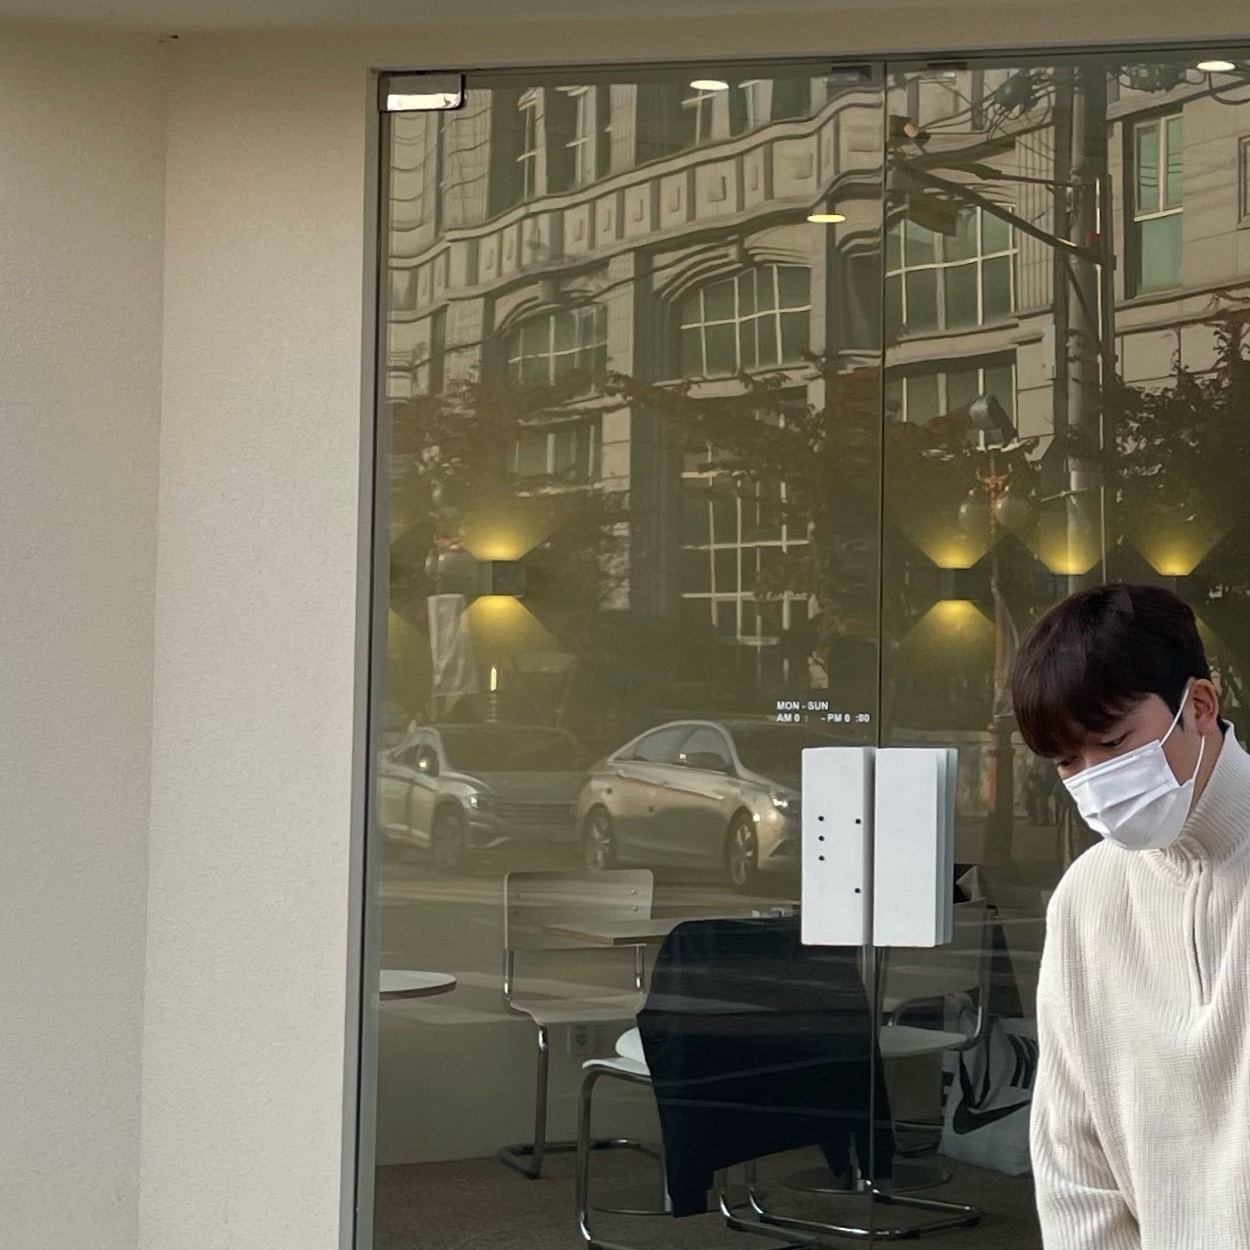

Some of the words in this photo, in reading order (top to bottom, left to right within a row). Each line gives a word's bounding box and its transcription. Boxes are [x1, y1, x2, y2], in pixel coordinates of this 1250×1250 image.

[776, 701, 800, 710] MON
[807, 701, 829, 710] SUN
[776, 713, 792, 722] AM
[827, 713, 842, 722] PM
